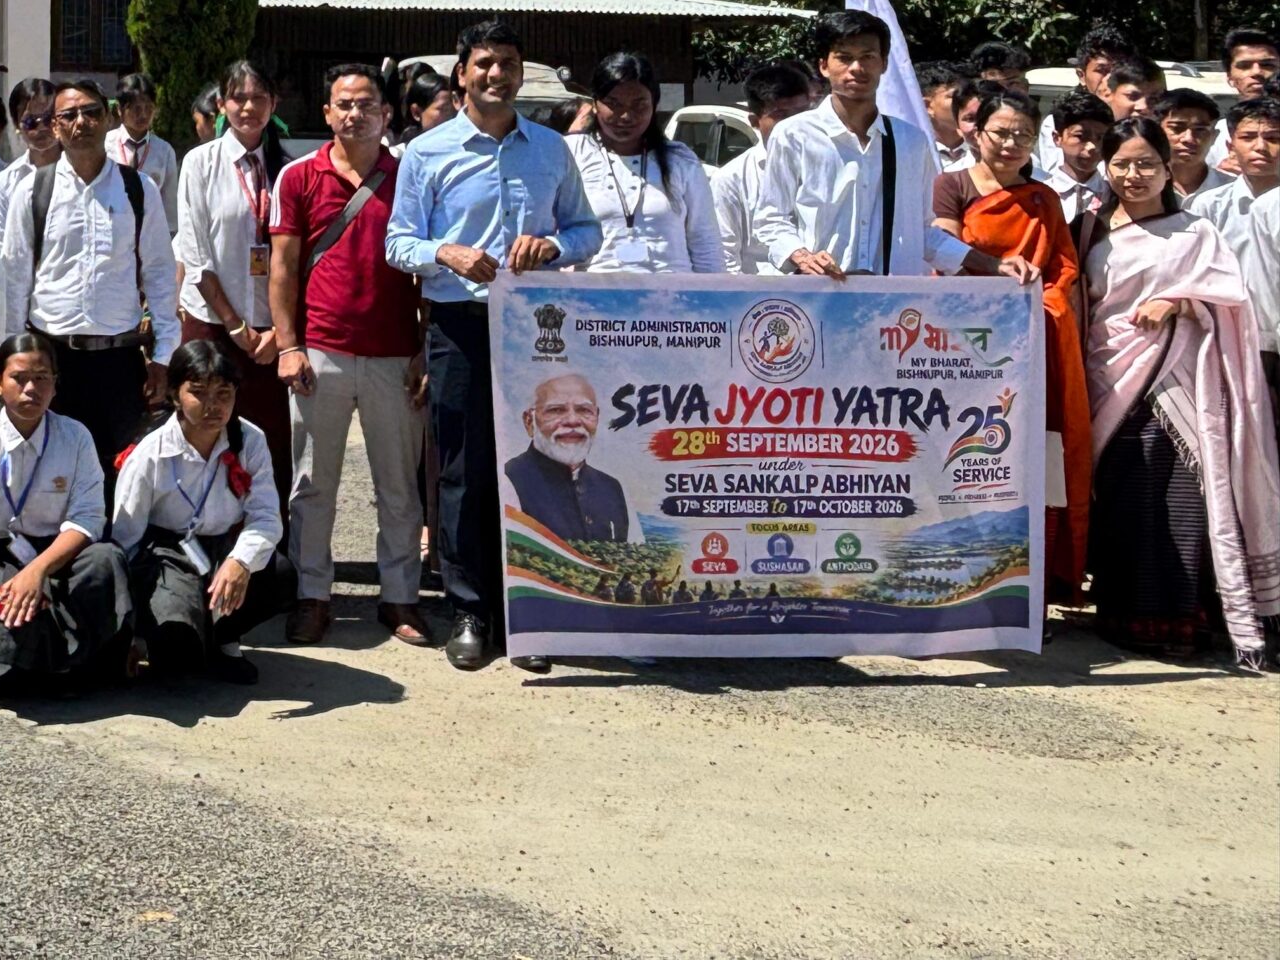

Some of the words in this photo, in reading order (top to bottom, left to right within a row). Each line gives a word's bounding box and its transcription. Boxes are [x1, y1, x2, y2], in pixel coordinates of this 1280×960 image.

[575, 319, 626, 332] DISTRICT
[630, 320, 727, 333] ADMINISTRATION
[589, 335, 662, 349] BISHNUPUR,
[666, 336, 721, 348] MANIPUR
[911, 358, 927, 367] MY
[930, 358, 973, 368] BHARAT,
[896, 369, 957, 380] BISHNUPUR,
[959, 370, 1004, 379] MANIPUR
[608, 382, 709, 432] SEVA
[714, 383, 825, 427] JYOTI
[832, 385, 951, 433] YATRA
[948, 405, 1012, 456] 25
[671, 430, 721, 456] 28th
[726, 432, 843, 455] SEPTEMBER
[848, 433, 900, 456] 2026
[758, 457, 807, 472] under
[960, 458, 989, 468] YEARS
[991, 457, 1002, 466] OF
[953, 466, 1011, 483] SERVICE
[664, 473, 718, 494] SEVA
[723, 473, 818, 494] SANKALP
[821, 473, 911, 494] ABHIYAN
[675, 499, 700, 514] 17th
[702, 499, 769, 514] SEPTEMBER
[771, 497, 788, 514] to
[793, 499, 817, 514] 17th
[819, 499, 872, 514] OCTOBER
[875, 499, 903, 514] 2026
[782, 523, 809, 532] AREAS
[701, 561, 728, 573] SEVA
[757, 561, 805, 573] SUSHASAN
